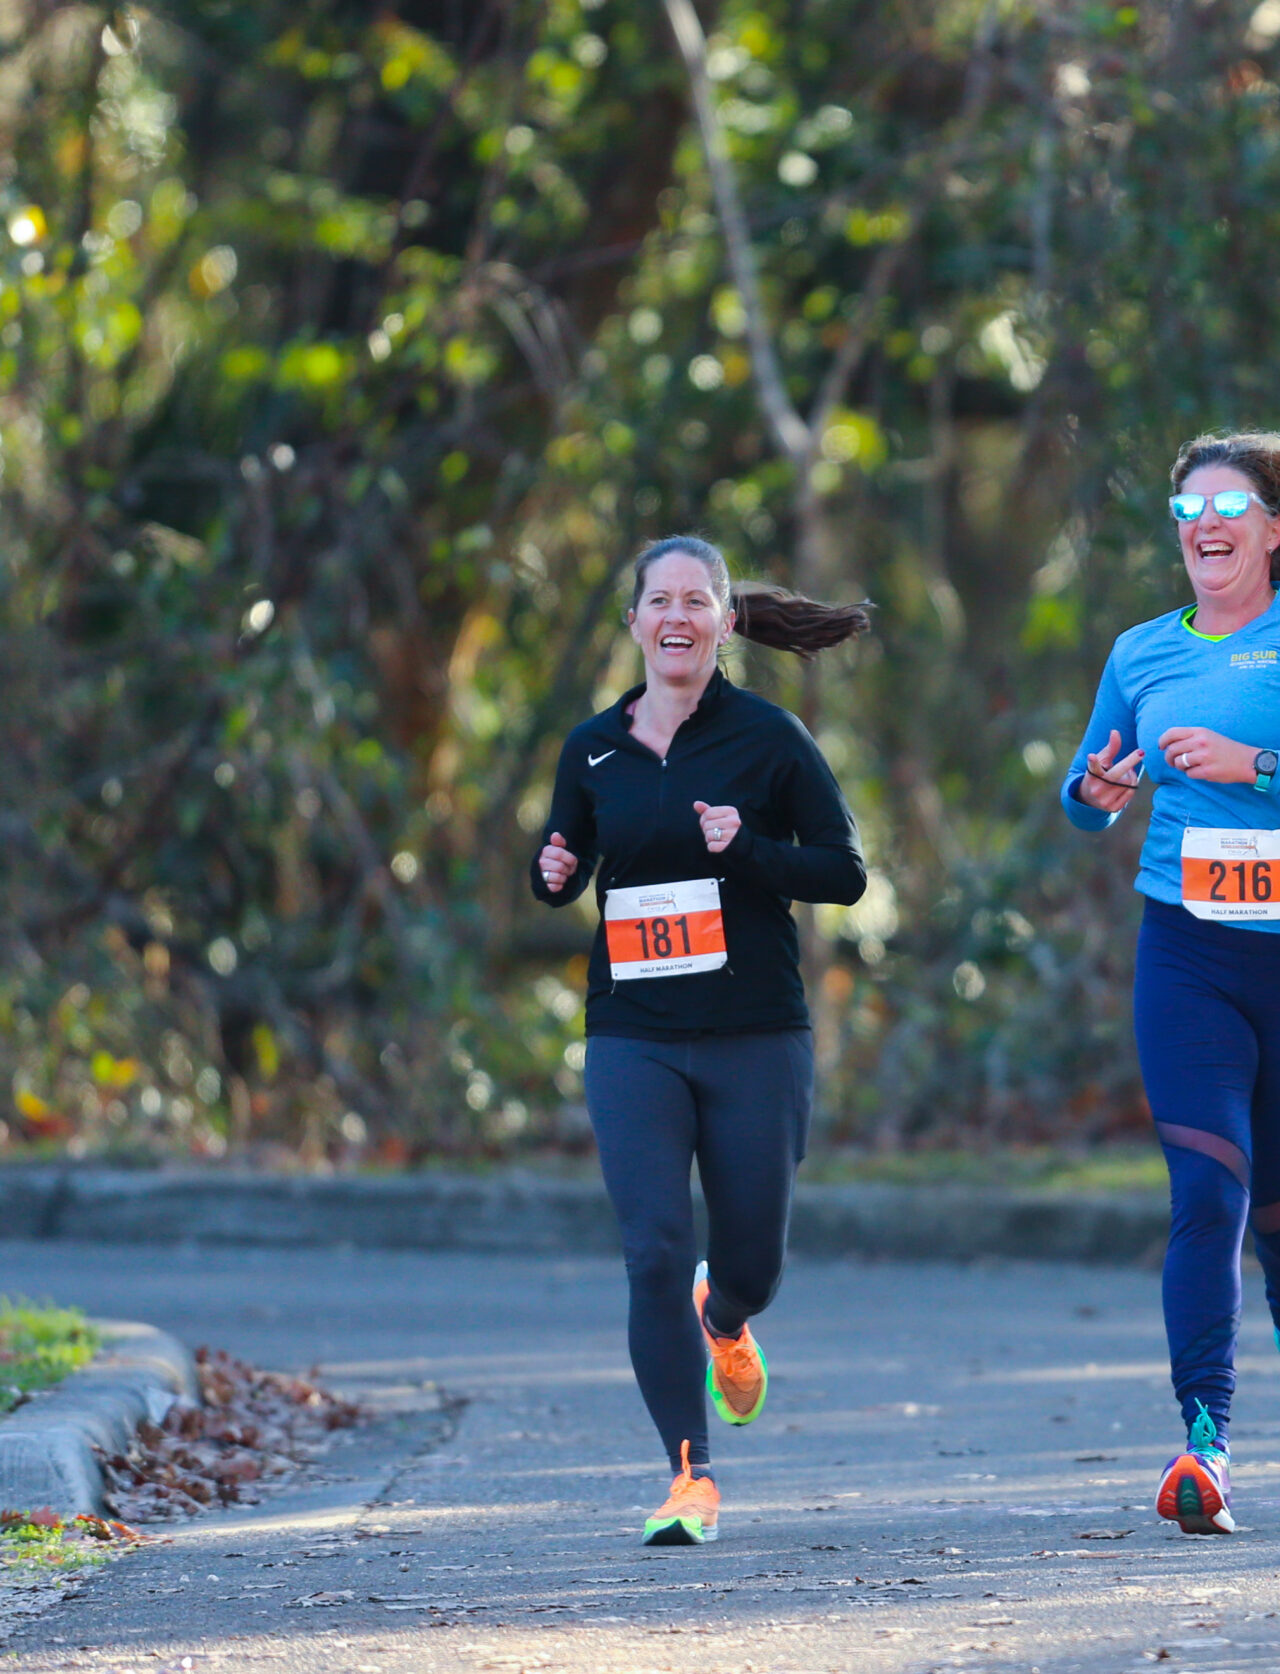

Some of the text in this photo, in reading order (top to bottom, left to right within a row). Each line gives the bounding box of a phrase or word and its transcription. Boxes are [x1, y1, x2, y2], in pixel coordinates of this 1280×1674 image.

[1231, 650, 1278, 662] BIG SUR
[1209, 860, 1272, 901] 216
[635, 915, 691, 959] 181
[656, 963, 693, 972] MARATHON
